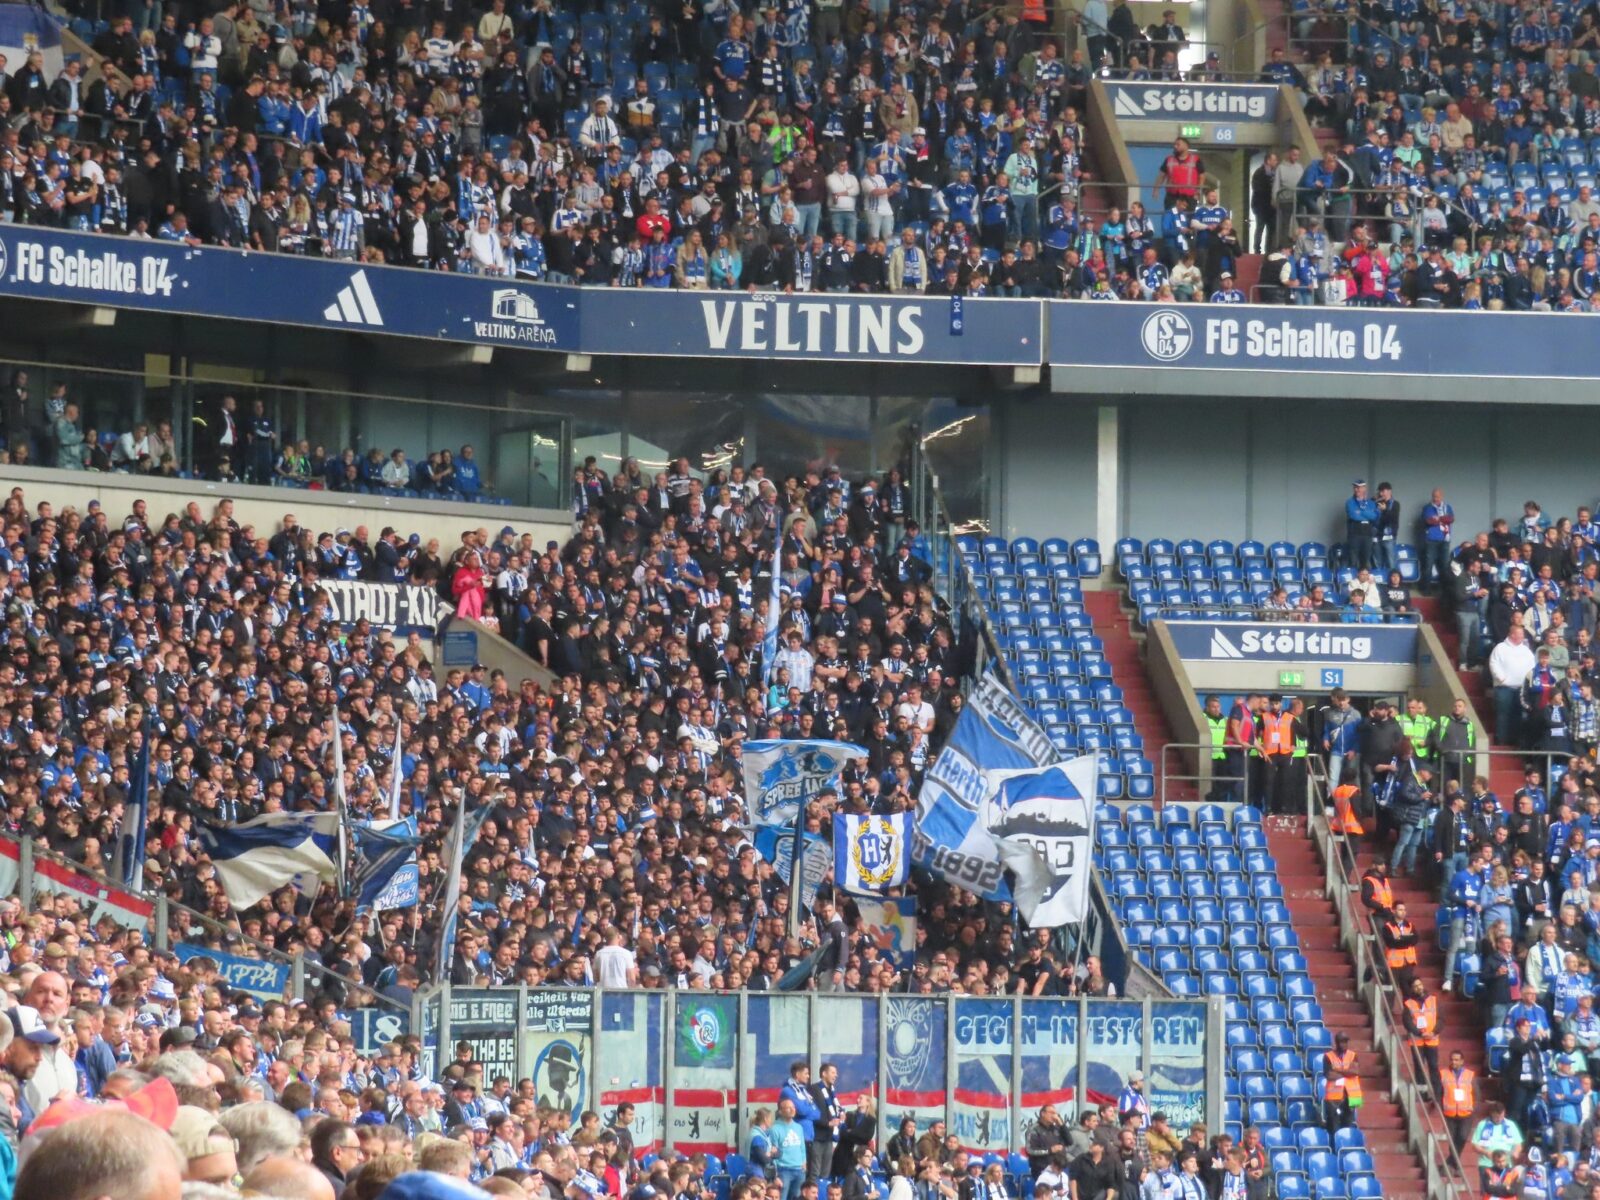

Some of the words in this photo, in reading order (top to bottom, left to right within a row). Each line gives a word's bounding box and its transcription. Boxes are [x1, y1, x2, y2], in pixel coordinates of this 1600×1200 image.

[1143, 89, 1266, 117] Stölting
[1216, 130, 1232, 140] 68
[17, 242, 44, 283] FC
[50, 246, 136, 293] Schalke
[142, 256, 172, 296] 04
[475, 321, 516, 340] VELTINS
[517, 326, 557, 343] ARENA
[700, 300, 924, 354] VELTINS
[1206, 319, 1239, 355] FC
[1246, 320, 1356, 359] Schalke
[1363, 323, 1402, 360] 04
[1241, 628, 1372, 660] Stölting
[1324, 671, 1340, 684] S1
[932, 845, 1002, 893] 1892
